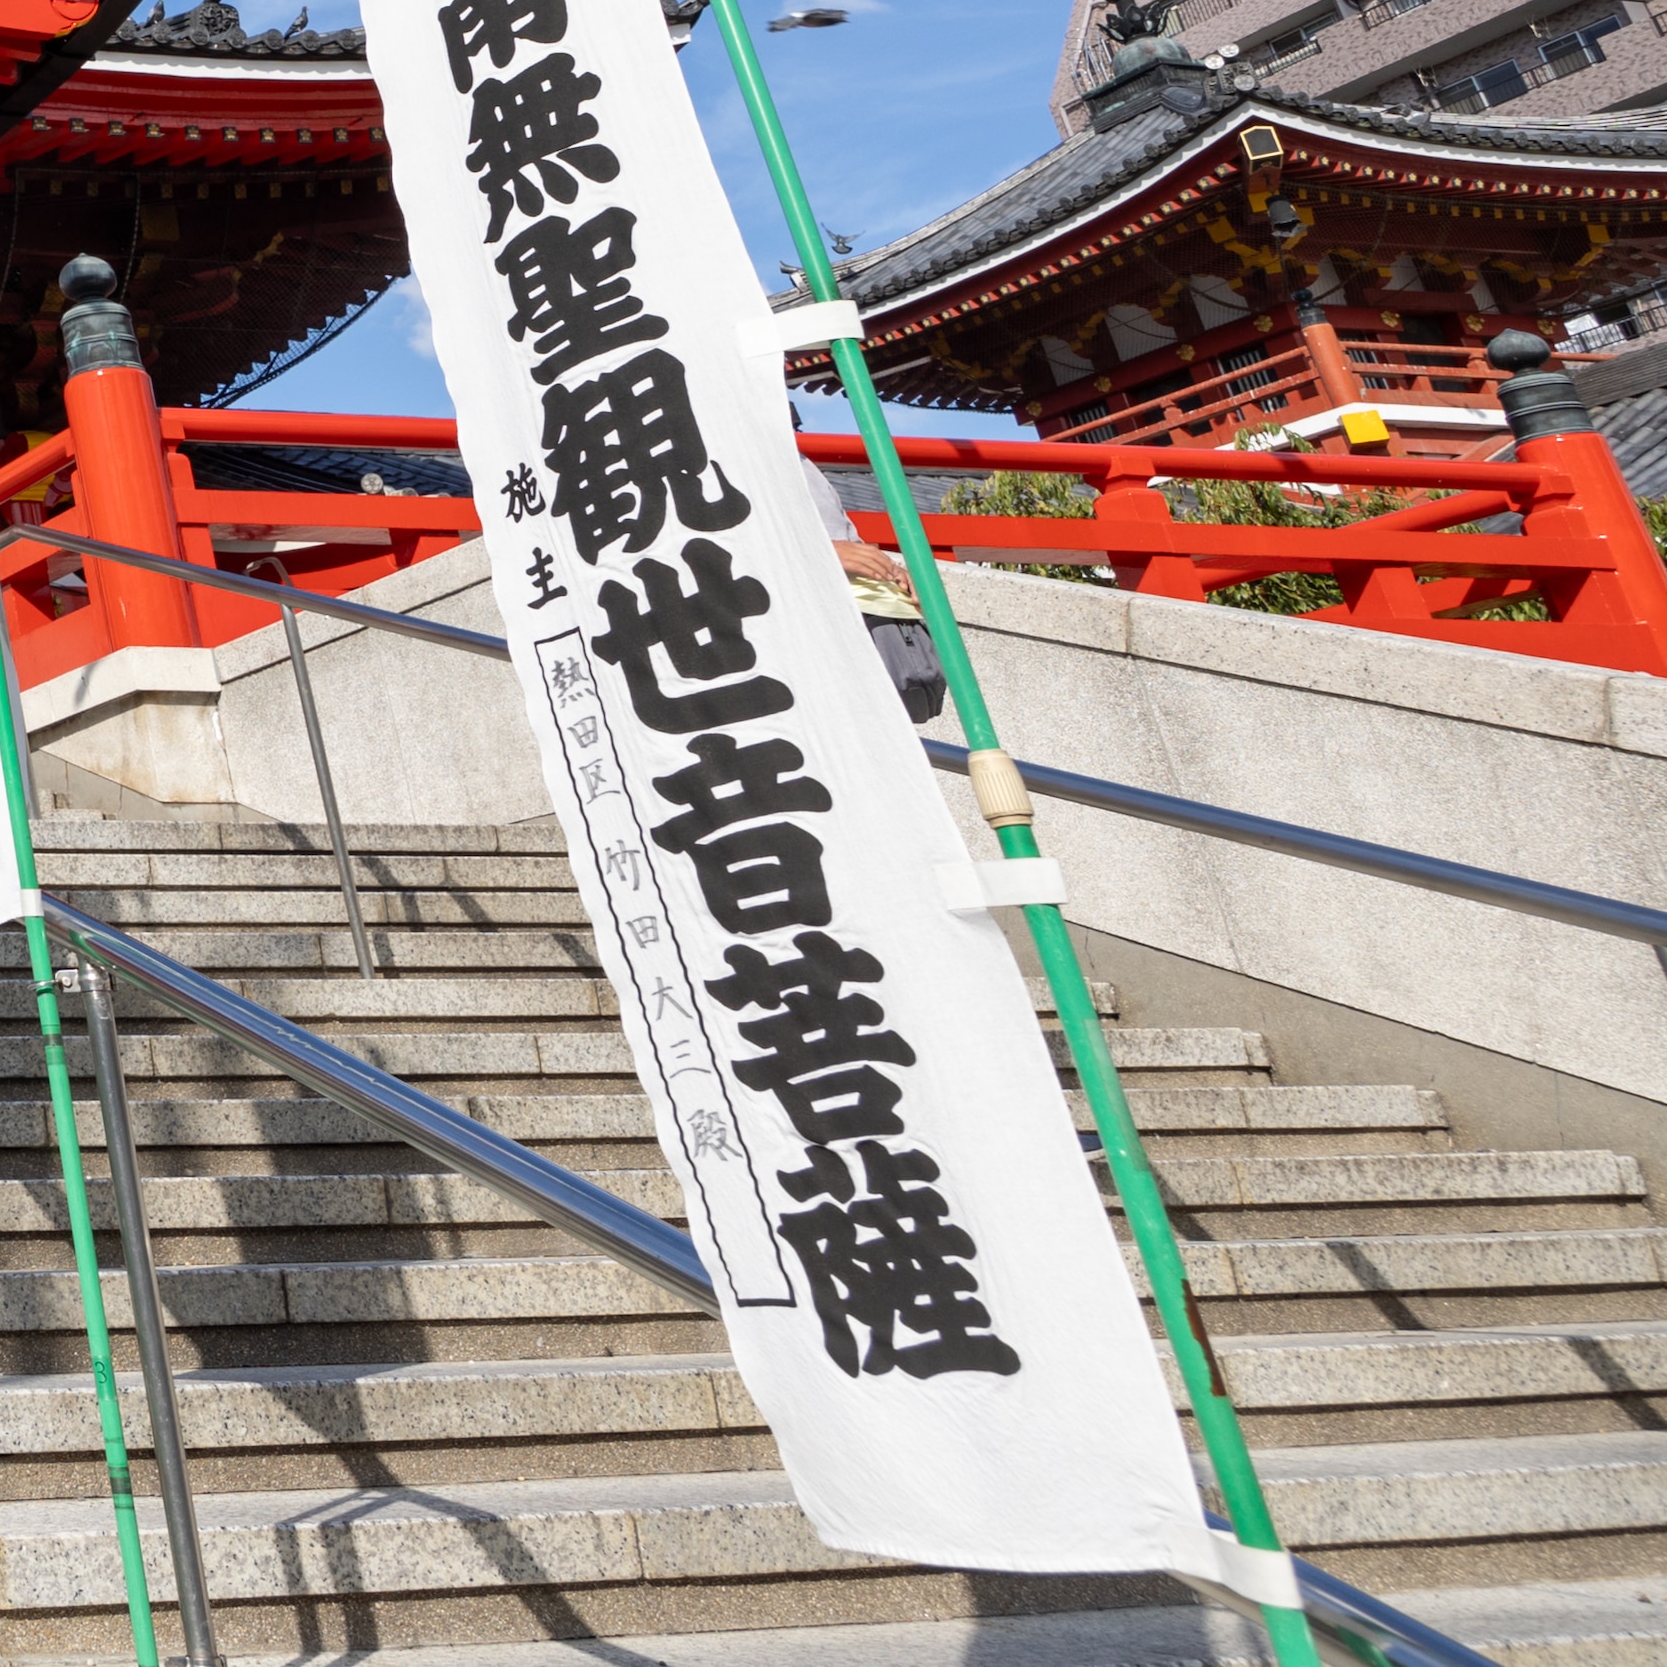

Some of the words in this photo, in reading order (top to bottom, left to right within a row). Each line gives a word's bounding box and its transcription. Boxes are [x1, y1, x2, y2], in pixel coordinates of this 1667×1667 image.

[500, 462, 568, 610] 施主
[551, 656, 621, 805] 熱田区
[604, 838, 713, 1079] 竹田大三
